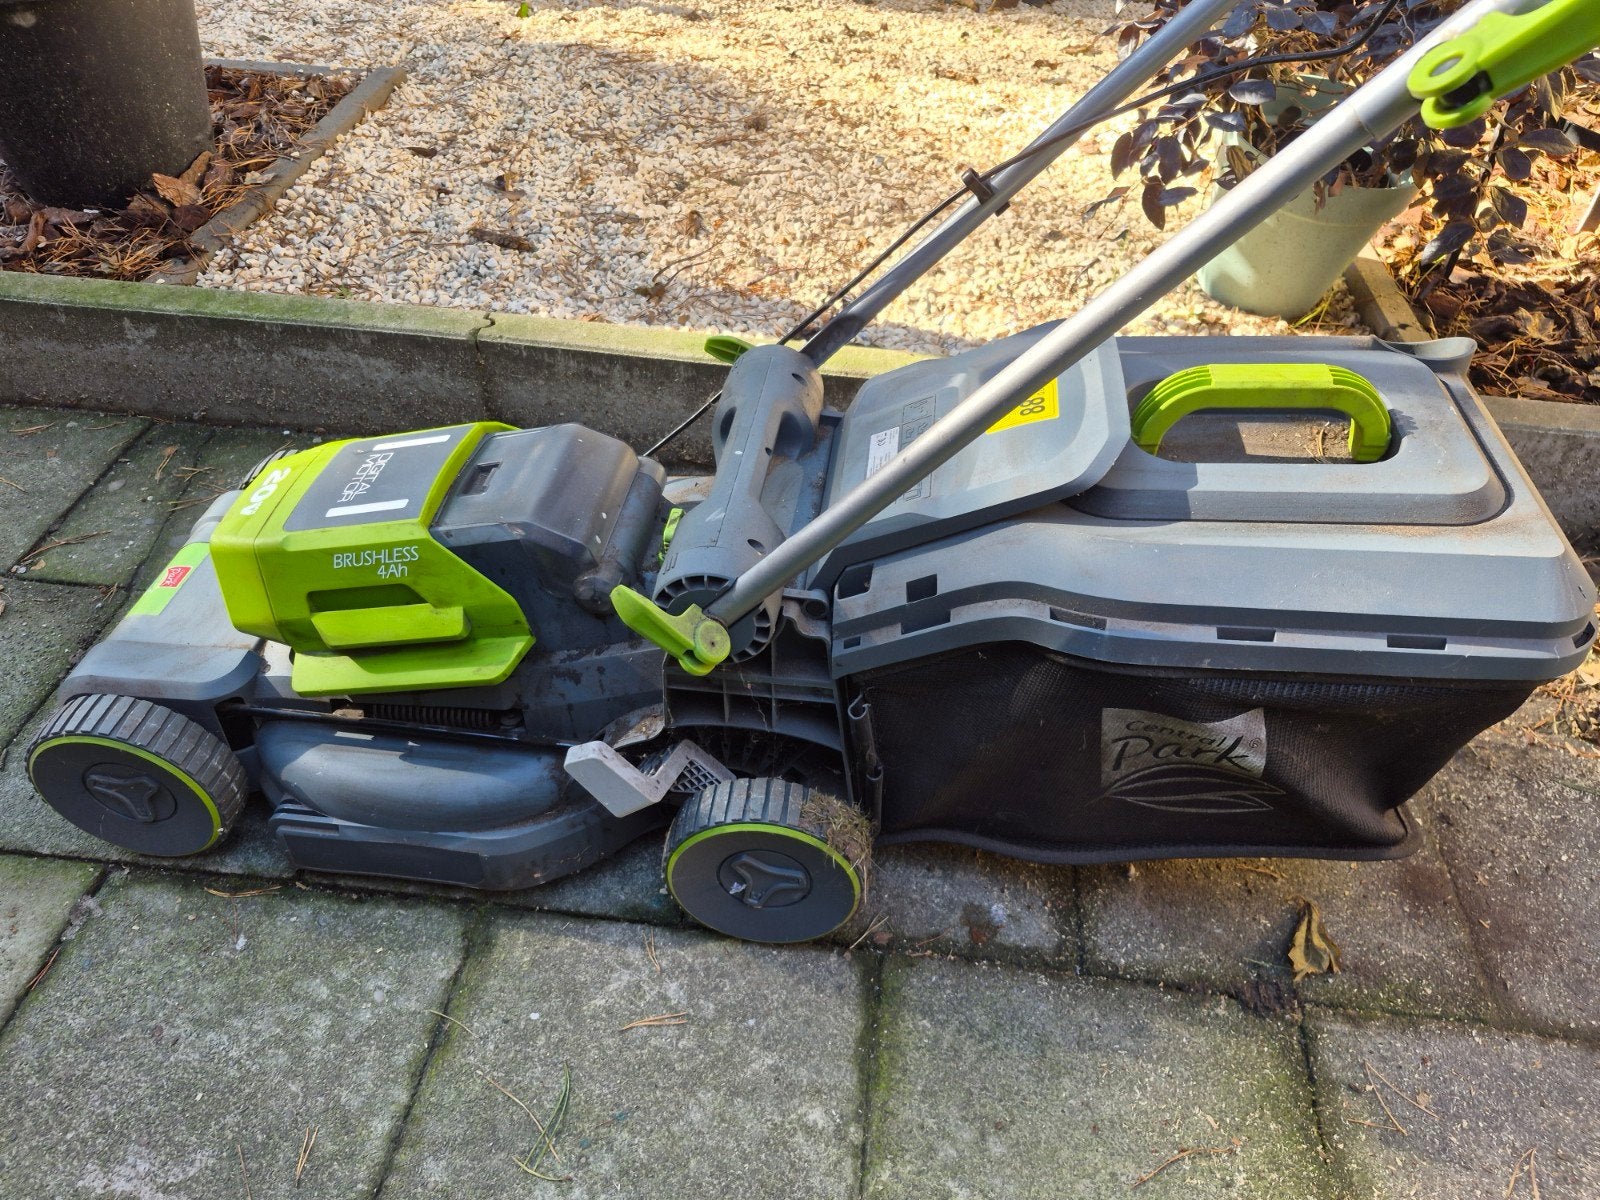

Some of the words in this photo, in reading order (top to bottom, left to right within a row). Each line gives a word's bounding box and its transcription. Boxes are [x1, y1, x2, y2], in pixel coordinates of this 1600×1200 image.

[1019, 397, 1046, 416] 88
[337, 454, 381, 503] MOTOR
[350, 452, 394, 501] DIGITAL
[333, 546, 419, 569] BRUSHLESS
[377, 563, 408, 579] 4Ah
[1126, 720, 1228, 747] Central
[1111, 735, 1251, 772] Park
